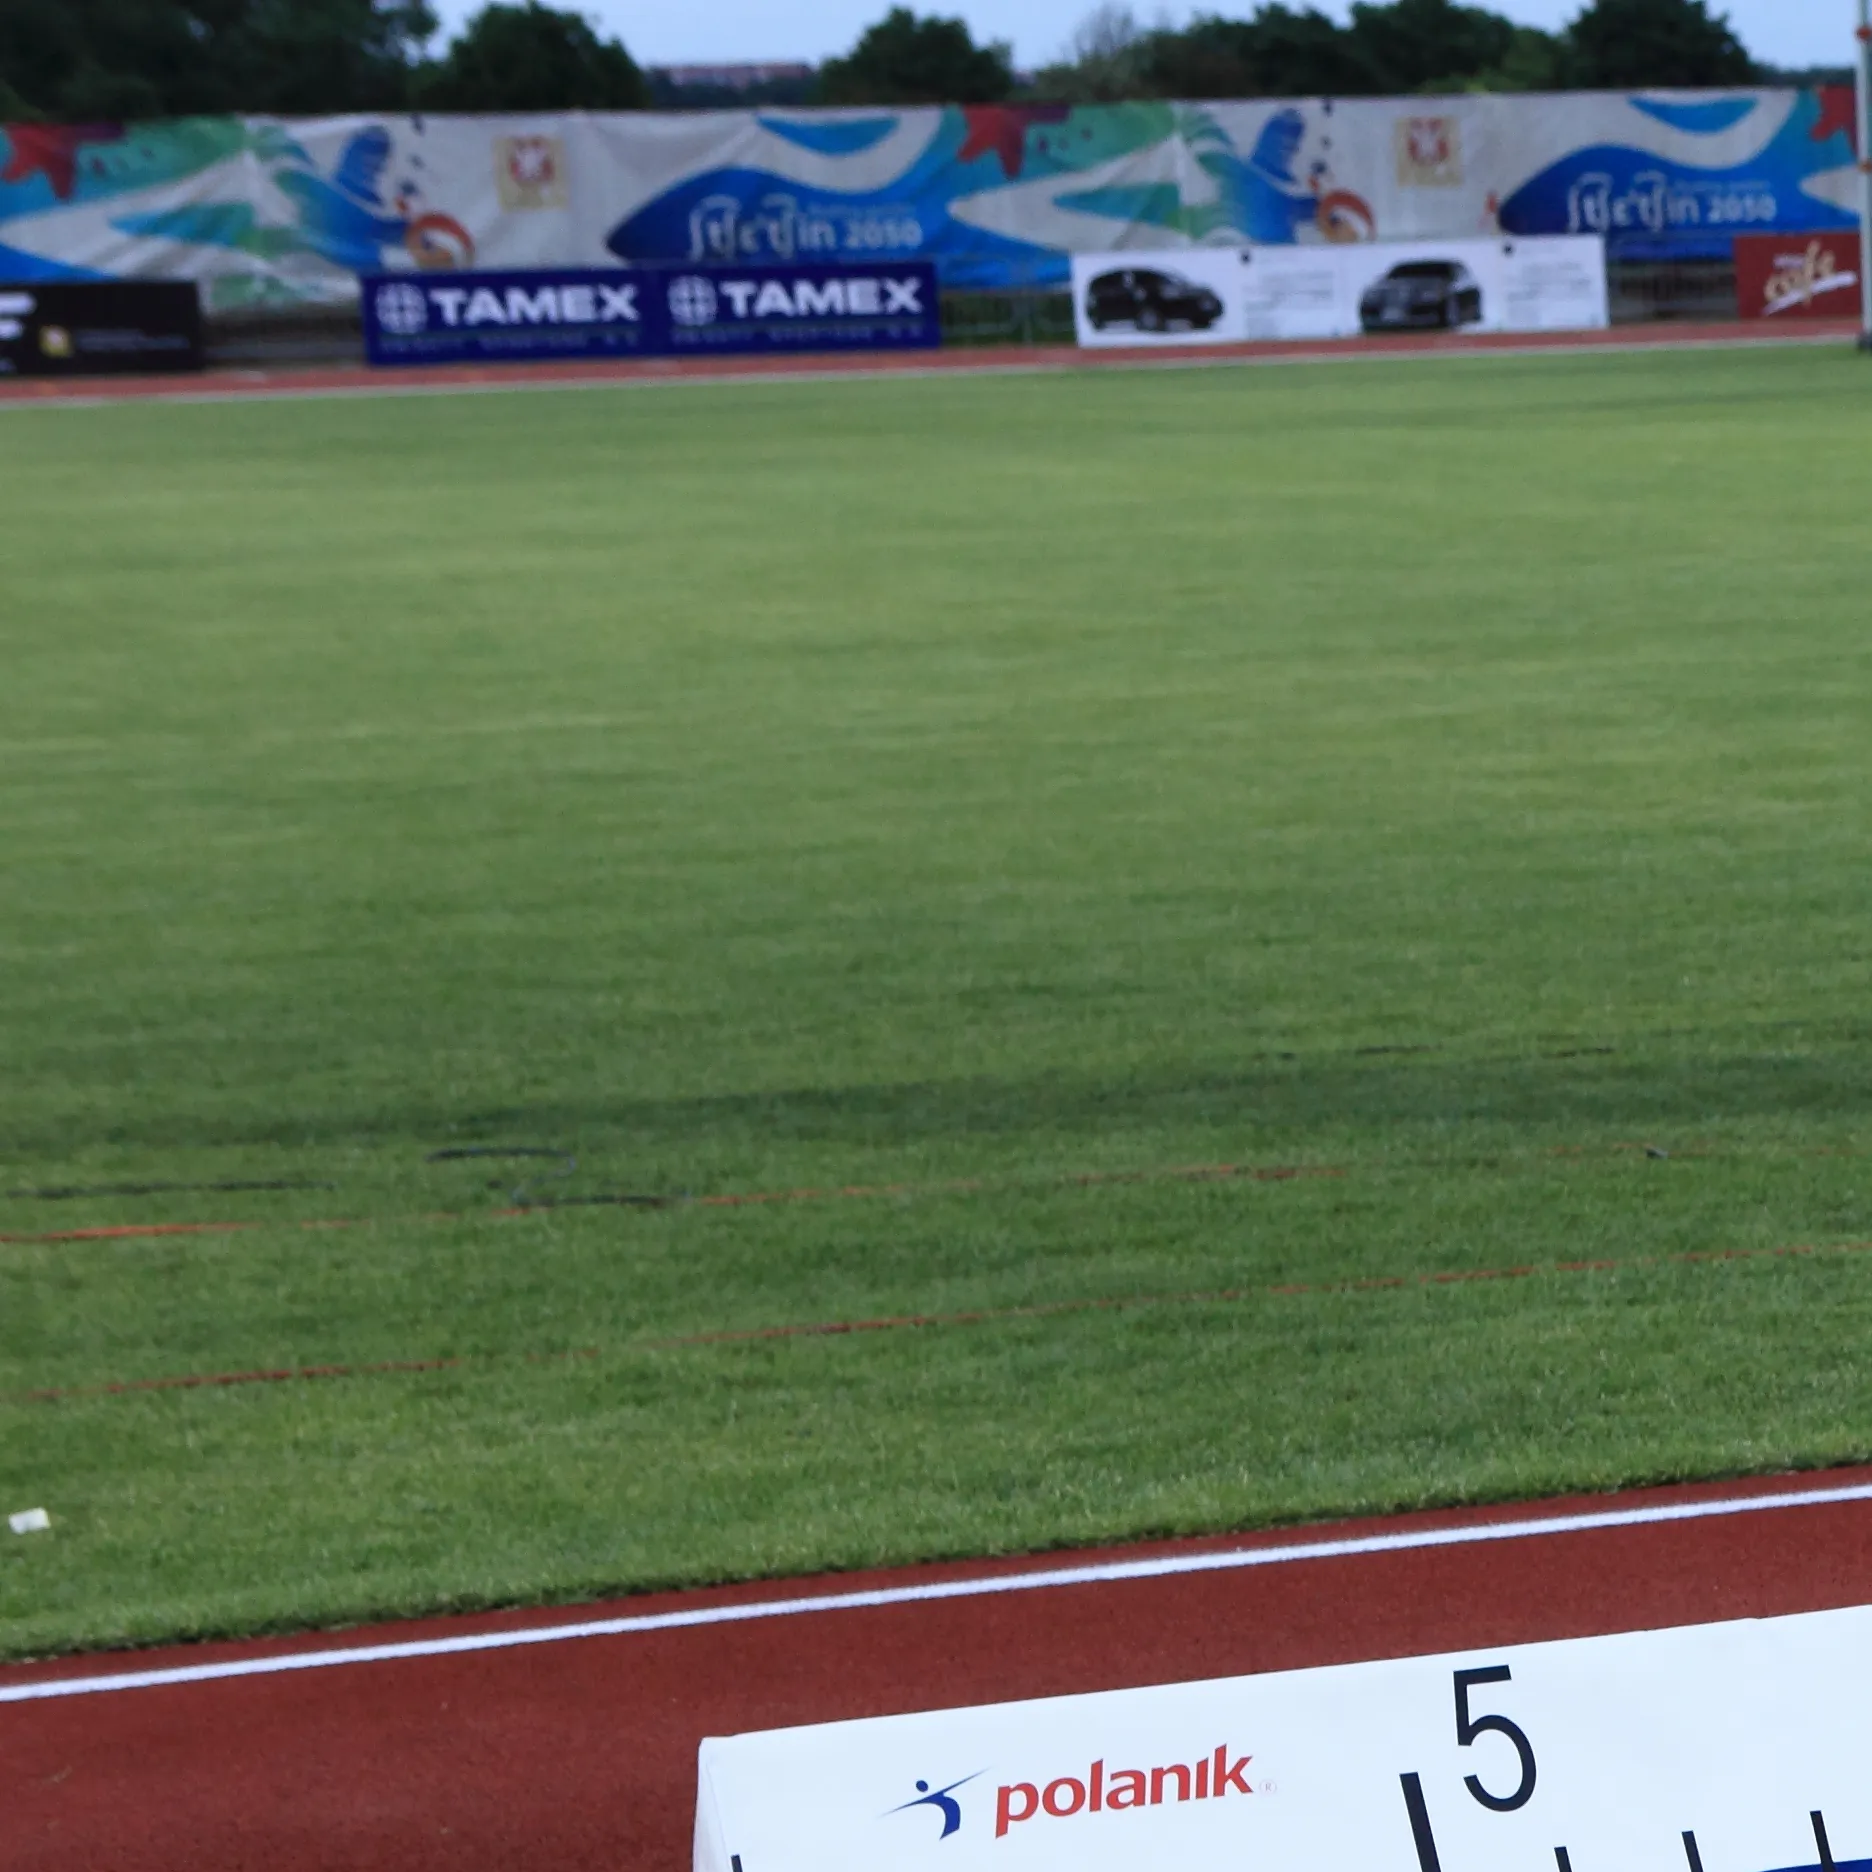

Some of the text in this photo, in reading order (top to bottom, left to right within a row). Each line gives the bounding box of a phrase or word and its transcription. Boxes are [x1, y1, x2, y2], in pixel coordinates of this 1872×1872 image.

[845, 216, 923, 249] 2050
[429, 283, 640, 327] TAMEX
[719, 276, 923, 318] TAMEX
[1452, 1664, 1537, 1813] 5
[995, 1744, 1254, 1838] polanik
